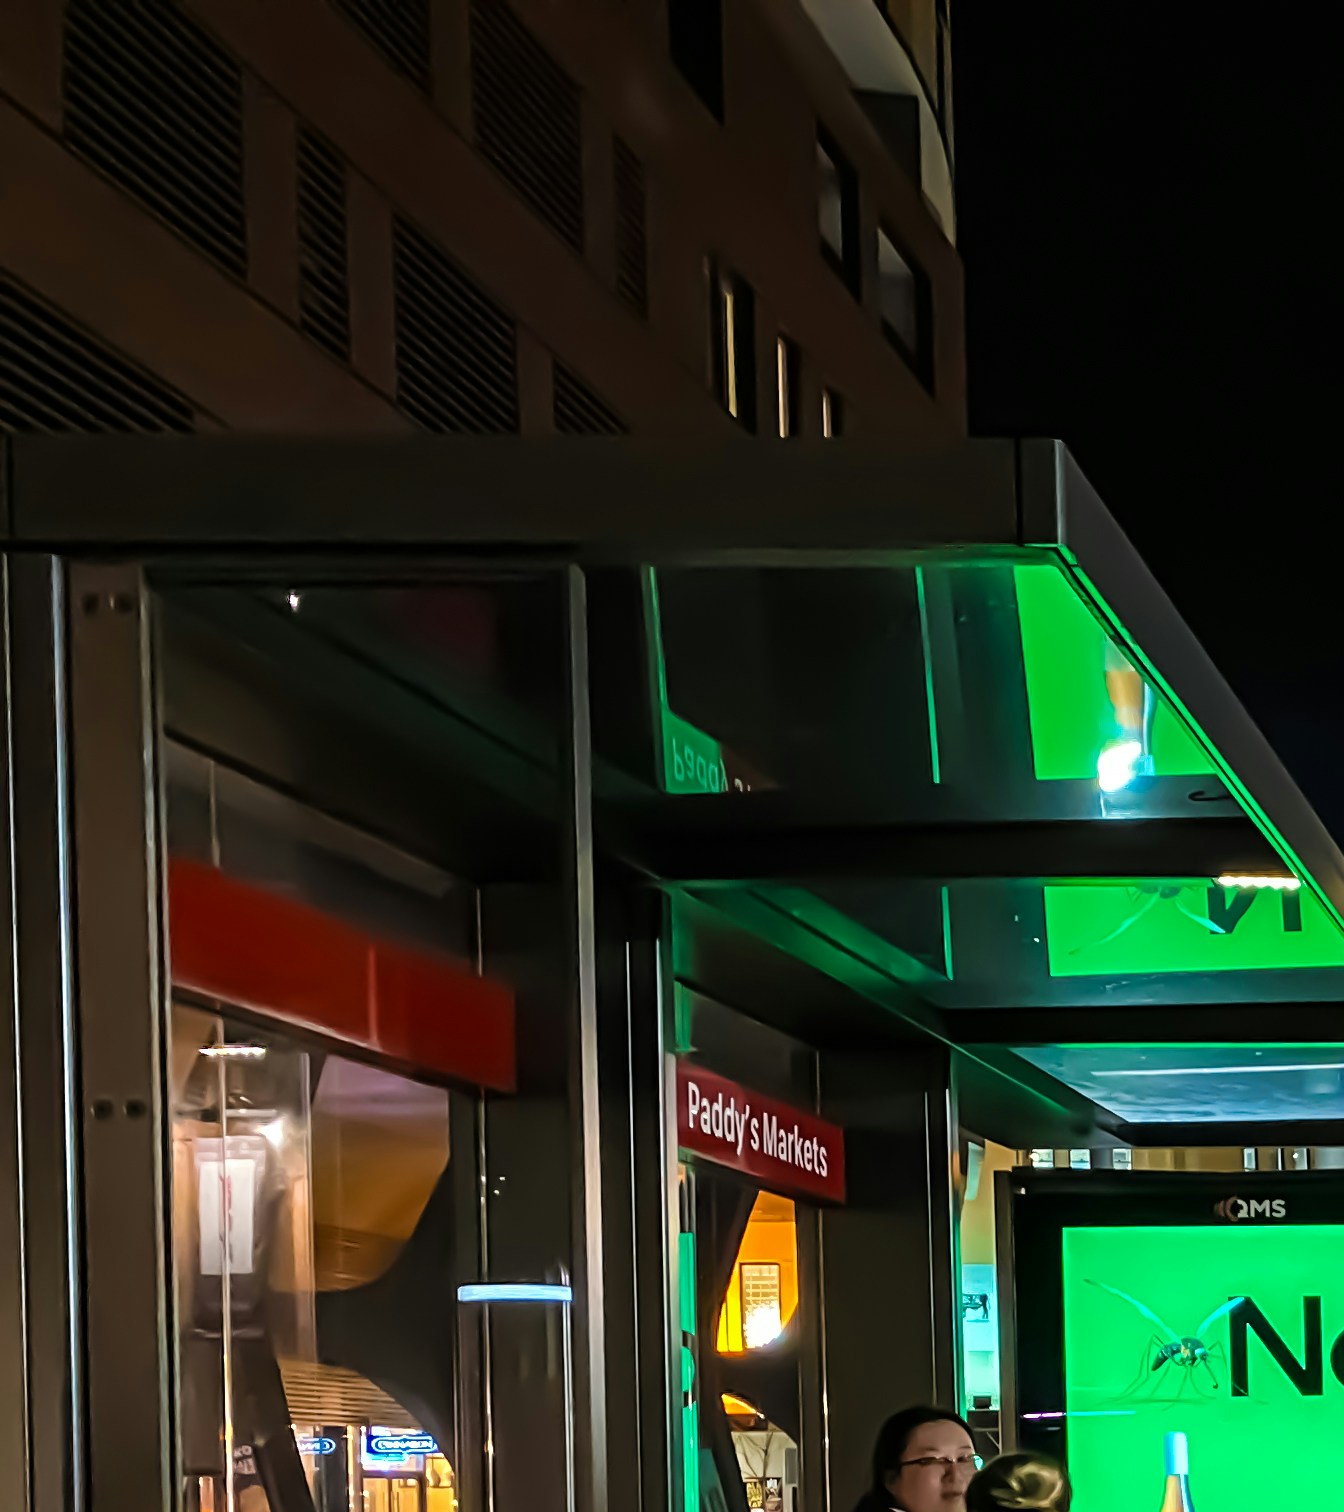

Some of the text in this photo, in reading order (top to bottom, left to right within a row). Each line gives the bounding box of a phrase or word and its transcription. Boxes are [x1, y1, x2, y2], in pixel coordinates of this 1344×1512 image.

[688, 1081, 828, 1178] Paddy's Markets
[1225, 1196, 1286, 1221] QMS
